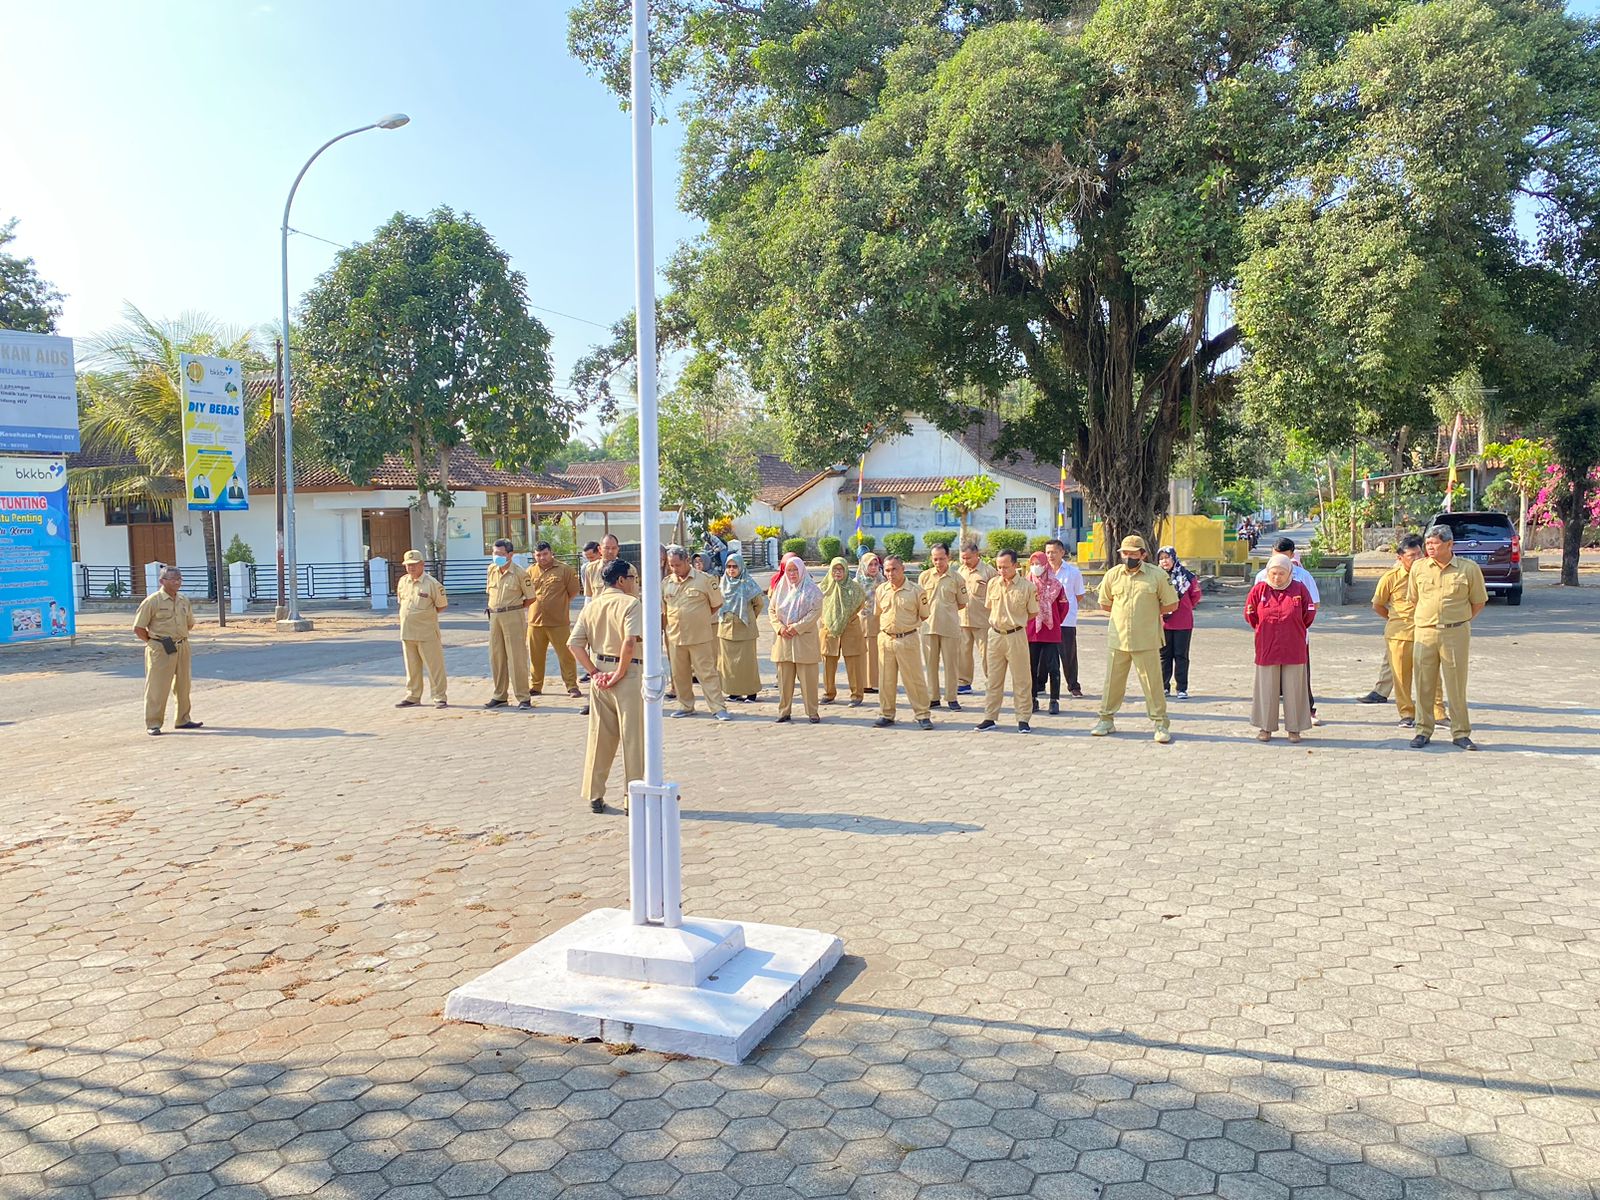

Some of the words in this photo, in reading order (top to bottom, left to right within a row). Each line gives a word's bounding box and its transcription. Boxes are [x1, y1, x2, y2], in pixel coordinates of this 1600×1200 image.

[36, 349, 69, 367] AIDS
[29, 369, 55, 378] LEWAT
[188, 401, 206, 413] DIY
[209, 403, 240, 416] BEBAS
[15, 468, 53, 479] bkkbn
[11, 513, 43, 525] Penting
[9, 527, 32, 536] Keren
